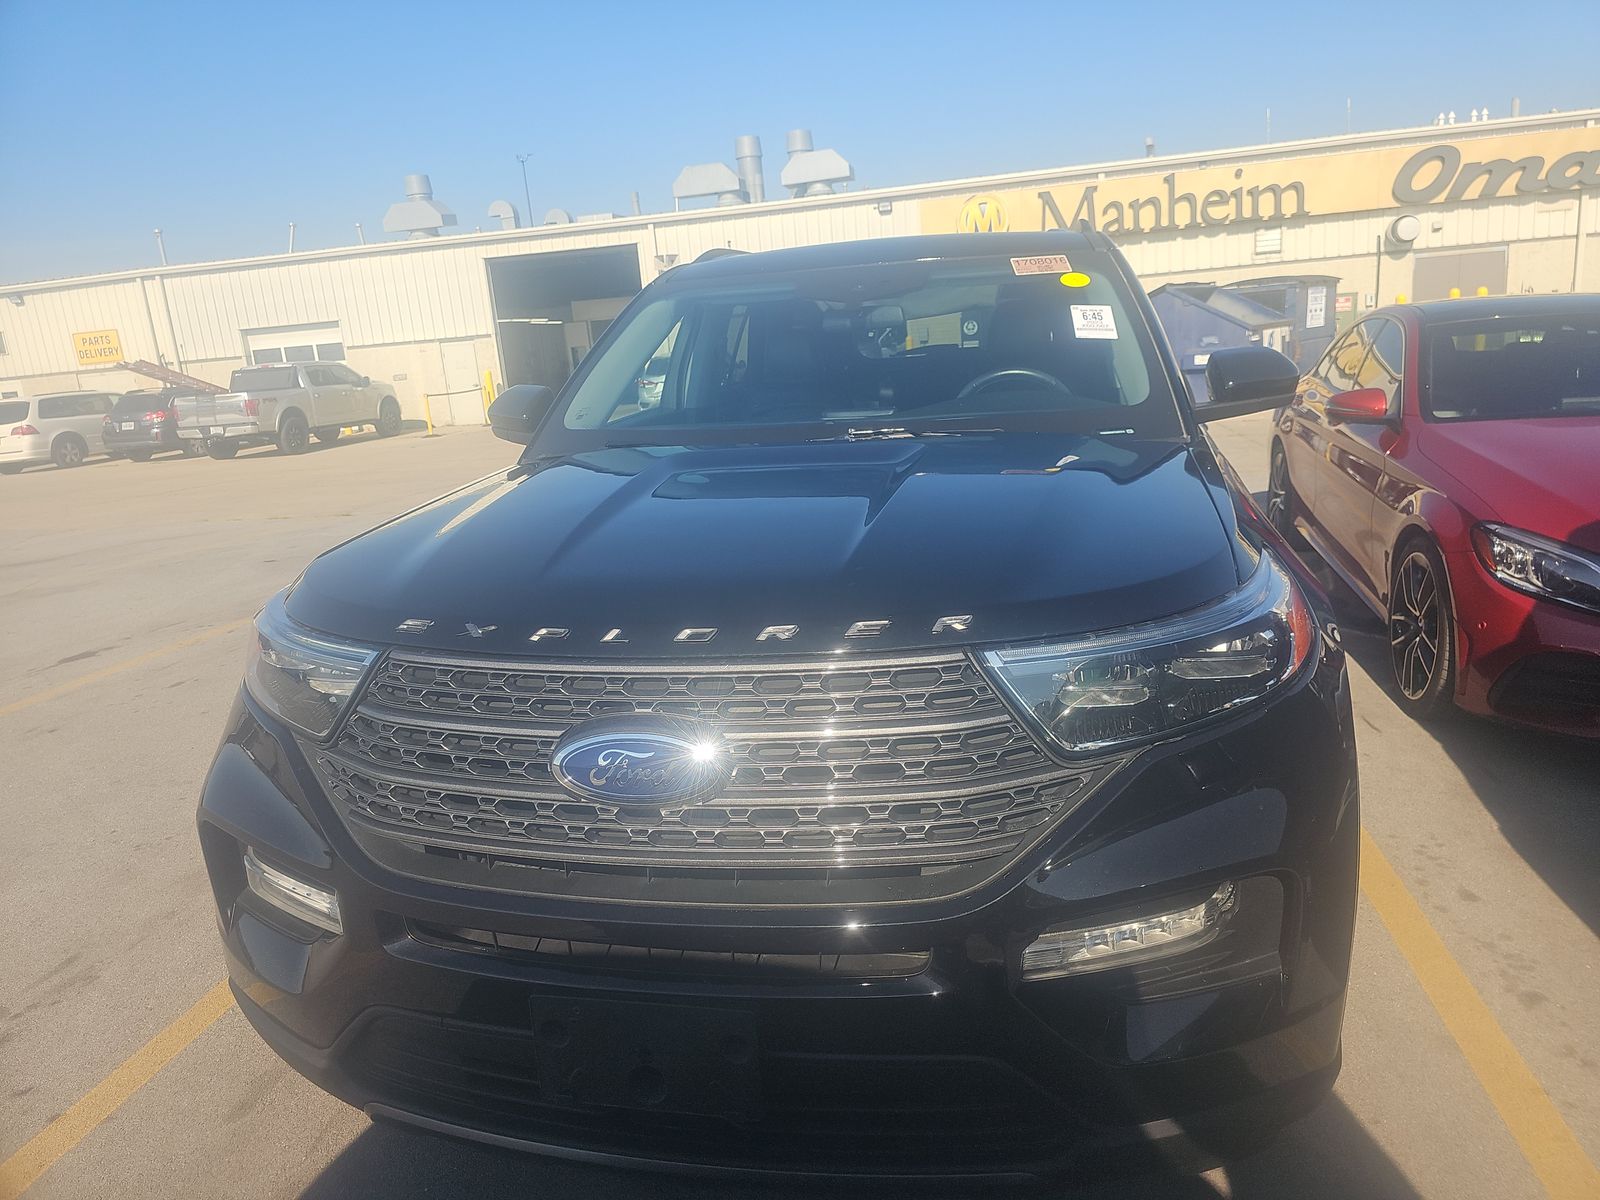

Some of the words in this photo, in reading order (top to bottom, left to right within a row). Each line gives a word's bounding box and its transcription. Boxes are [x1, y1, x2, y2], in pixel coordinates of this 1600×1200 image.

[1038, 168, 1312, 235] Manheim
[1082, 311, 1103, 321] 6:45
[82, 335, 111, 346] PARTS
[79, 346, 119, 359] DELIVERY
[395, 614, 974, 644] EXPLORER
[589, 749, 681, 787] Ford
